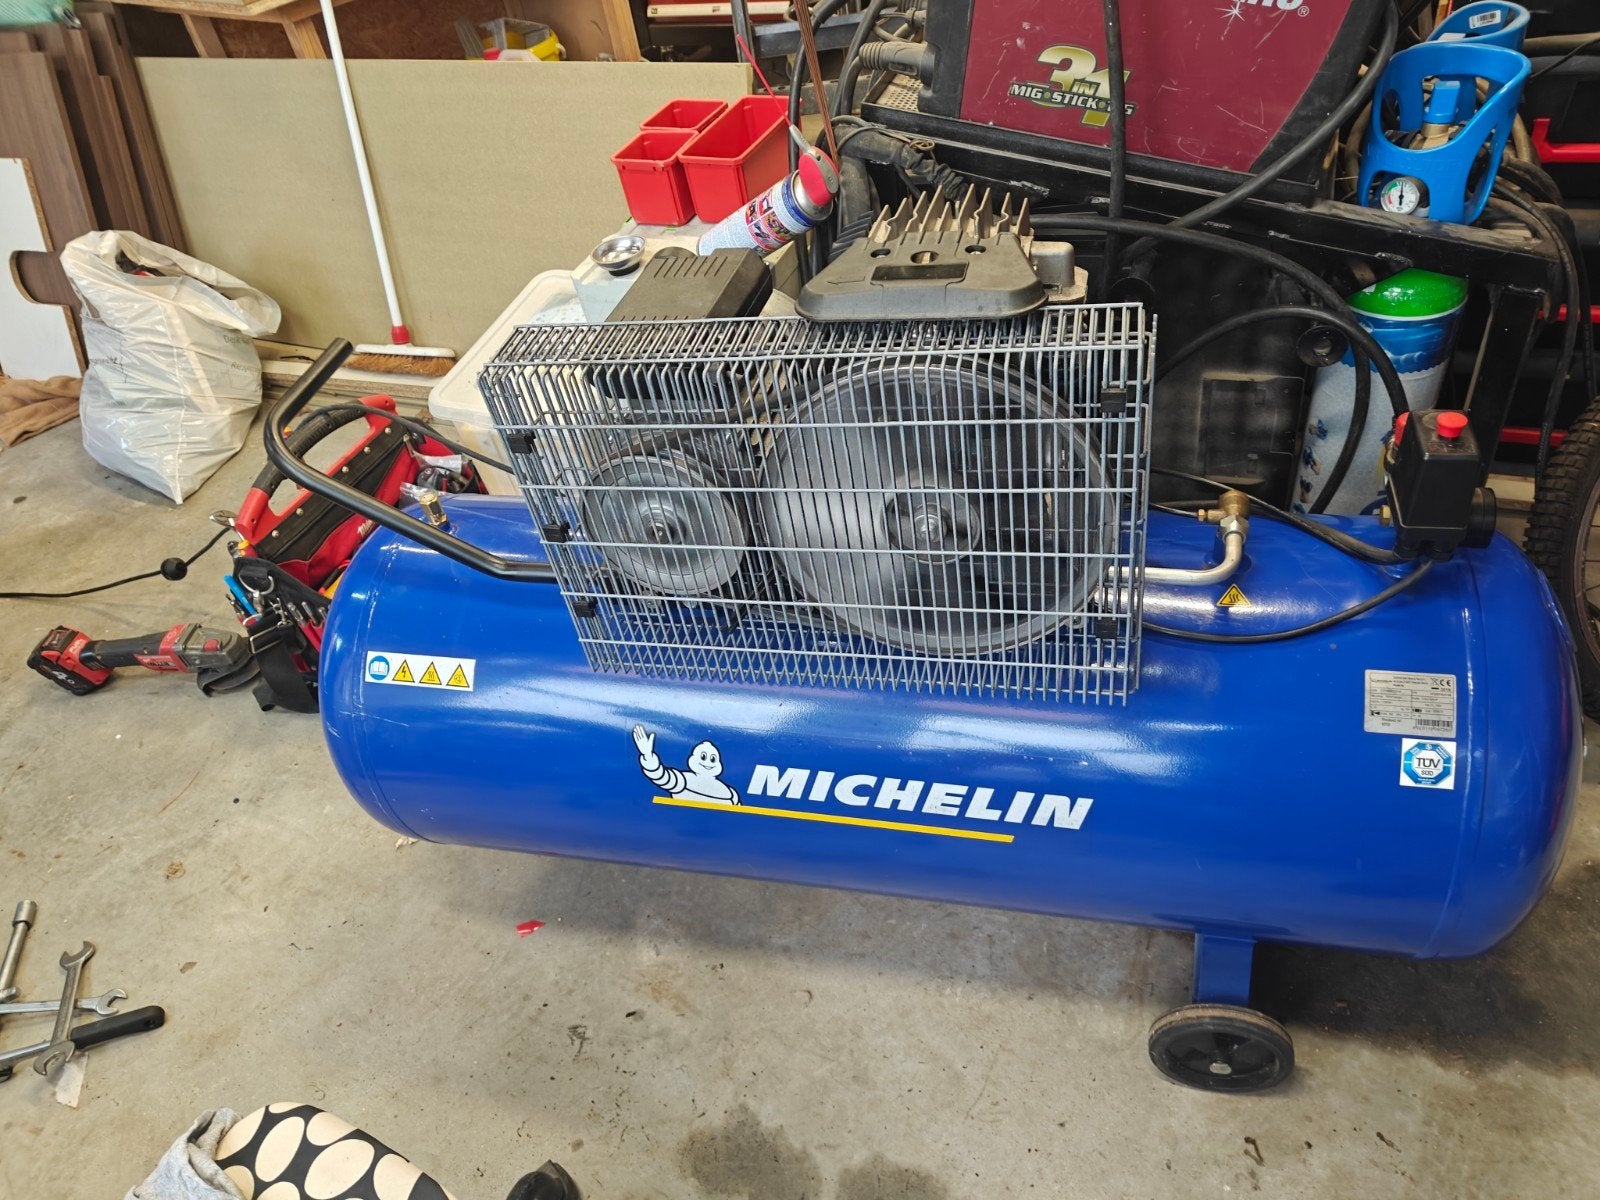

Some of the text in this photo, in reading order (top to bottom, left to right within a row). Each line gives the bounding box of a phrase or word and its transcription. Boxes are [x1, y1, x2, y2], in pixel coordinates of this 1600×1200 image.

[1008, 84, 1043, 100] MIG
[1051, 91, 1099, 110] STICK
[1037, 45, 1097, 93] 3
[1070, 81, 1097, 97] IN
[747, 764, 1094, 830] MICHELIN
